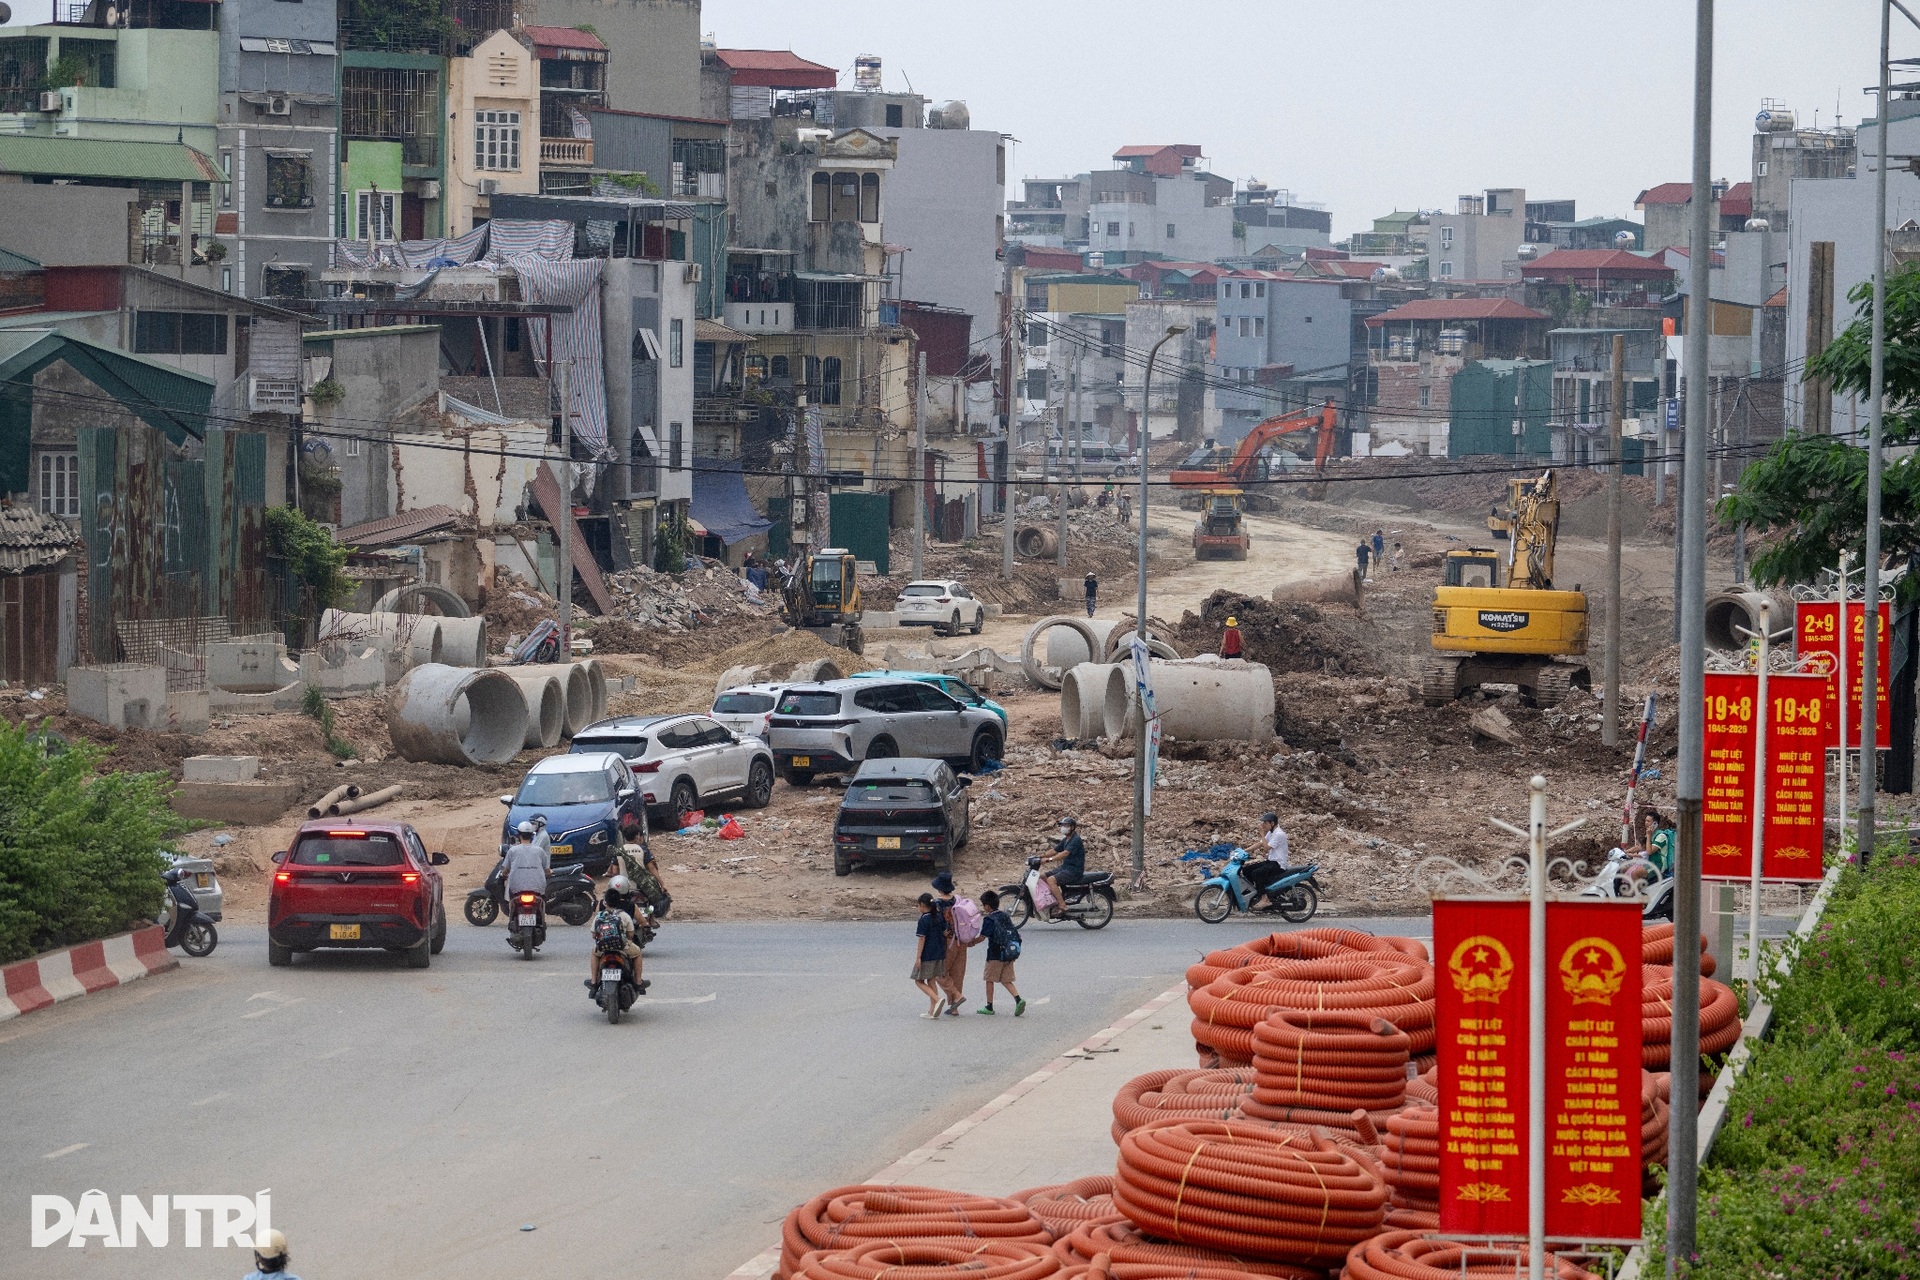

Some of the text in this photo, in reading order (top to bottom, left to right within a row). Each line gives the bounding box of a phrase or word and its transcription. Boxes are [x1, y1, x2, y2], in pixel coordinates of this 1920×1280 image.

[1480, 613, 1525, 623] KOMATSU
[1775, 698, 1820, 723] 19 8
[1708, 724, 1747, 733] 1945-2026
[1777, 726, 1817, 736] 1945-2026
